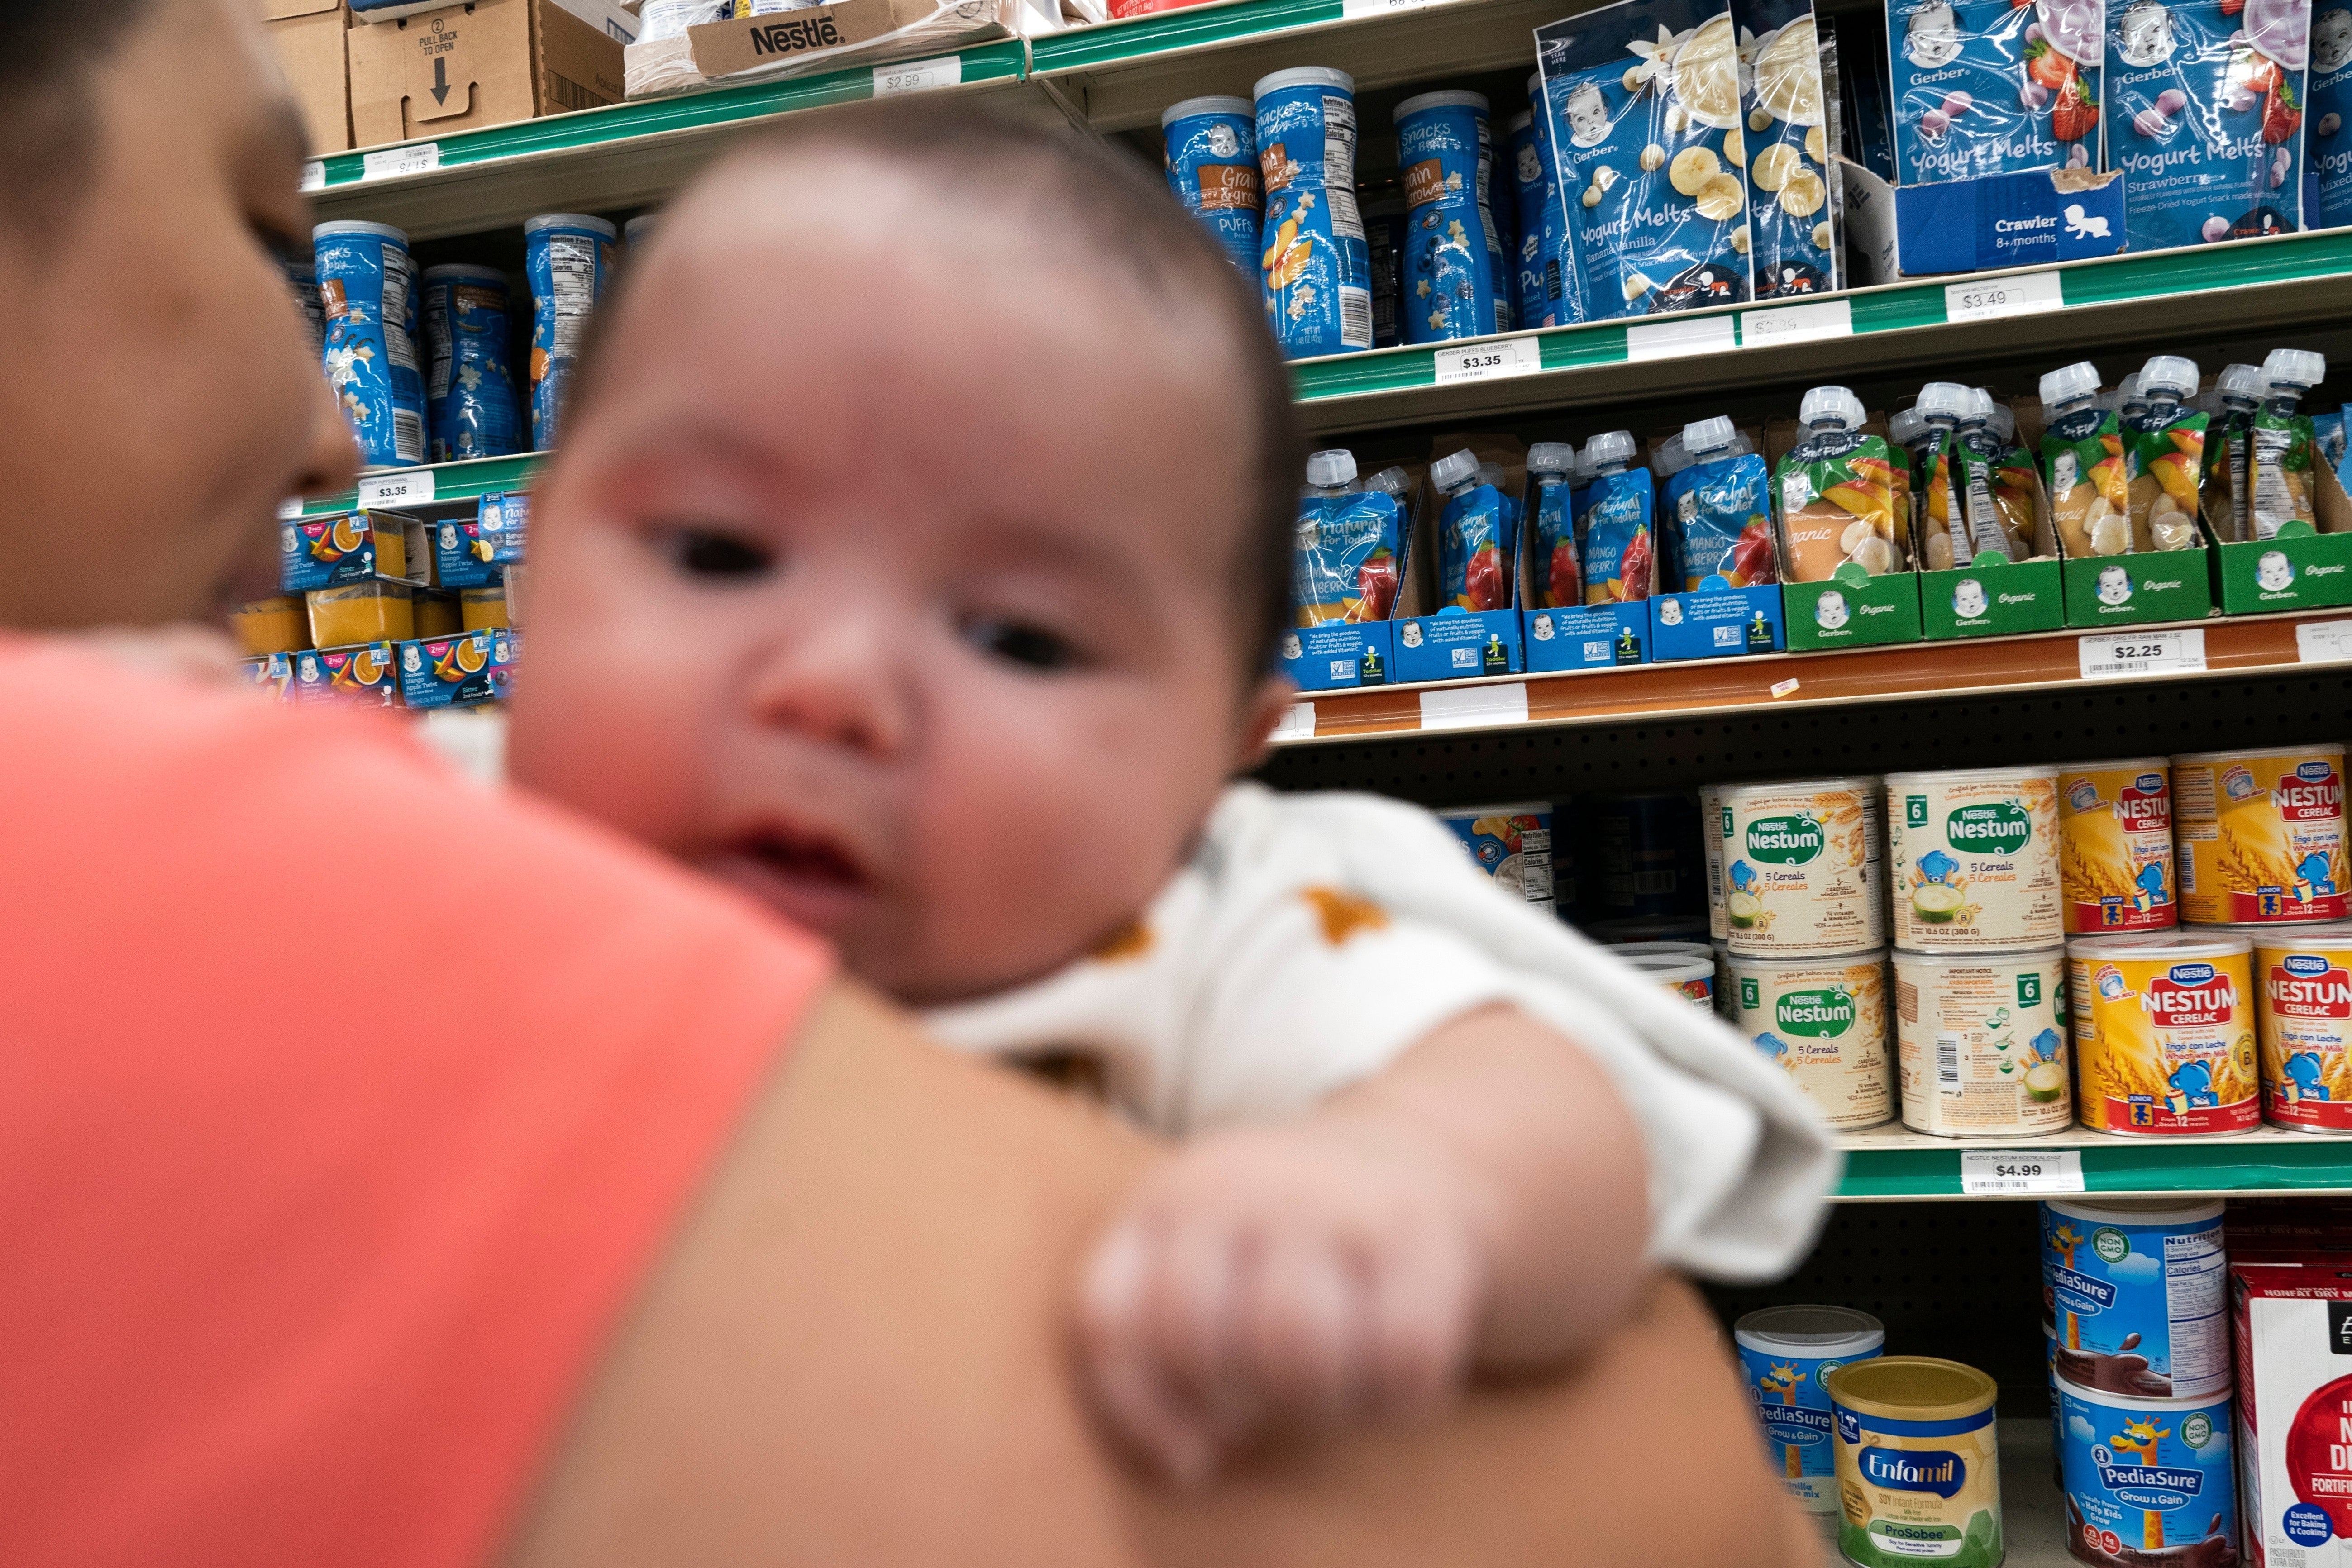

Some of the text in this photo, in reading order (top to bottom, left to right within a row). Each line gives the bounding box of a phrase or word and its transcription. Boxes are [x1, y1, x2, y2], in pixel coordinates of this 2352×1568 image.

[419, 30, 458, 47] PULL BACK
[424, 41, 454, 55] TO OPEN
[1551, 51, 1566, 60] TEAR
[1551, 56, 1566, 65] HERE
[887, 74, 919, 89] $2.99
[1910, 68, 1964, 86] Gerber
[2121, 67, 2180, 85] Gerber
[1572, 144, 1615, 165] Gerber
[1911, 135, 2054, 170] Yogurt Melts
[2121, 137, 2266, 176] Yogurt Melts
[2181, 198, 2206, 207] Yogurt
[2208, 194, 2230, 203] Snack
[1218, 218, 1253, 232] PUFFS
[1581, 203, 1691, 247] Yogurt Melts
[1995, 216, 2058, 233] Crawler
[2012, 233, 2057, 246] months
[1586, 245, 1616, 265] Banana
[1615, 236, 1656, 253] Vanilla
[1963, 292, 2006, 308] $3.49
[1437, 348, 1460, 357] GERBER
[1480, 343, 1512, 352] BLUEBERRY
[1463, 355, 1501, 369] $3.35
[379, 486, 407, 497] $3.35
[1322, 535, 1341, 547] for
[1689, 537, 1725, 550] MANGO
[1588, 547, 1616, 559] MANGO
[2305, 563, 2346, 577] Organic
[2143, 579, 2182, 592] Organic
[1998, 592, 2036, 605] Organic
[2259, 592, 2294, 601] Gerber
[1859, 604, 1895, 615] Organic
[2098, 605, 2132, 614] Gerber
[1955, 619, 1987, 627] Gerber
[1818, 629, 1849, 638] Gerber
[2115, 645, 2162, 658] $2.25
[1911, 804, 1921, 819] 6
[2297, 807, 2333, 818] CERELAC
[1949, 820, 2026, 839] Nestum
[1748, 832, 1818, 849] Nestum
[2293, 834, 2311, 844] Trigo
[1980, 861, 2014, 871] Cereals
[1773, 872, 1805, 881] Cereals
[1977, 873, 2017, 882] Cereales
[1772, 882, 1808, 891] Cereales
[2302, 903, 2314, 914] 12
[1746, 987, 1753, 1001] 6
[2024, 982, 2035, 998] 6
[2140, 987, 2238, 1012] NESTUM
[1779, 1005, 1850, 1023] Nestum
[2284, 1003, 2330, 1016] CERELAC
[2170, 1012, 2217, 1024] CERELAC
[2281, 1031, 2298, 1040] Trigo
[2316, 1034, 2342, 1043] Leche
[1807, 1044, 1839, 1054] Cereals
[2325, 1044, 2343, 1053] Milk
[1805, 1056, 1841, 1064] Cereales
[2176, 1115, 2189, 1126] 12
[1996, 1164, 2042, 1177] $4.99
[2099, 1238, 2121, 1246] NON
[2101, 1245, 2122, 1253] GMO
[2166, 1264, 2201, 1275] Calories
[2075, 1298, 2095, 1312] Gain
[1768, 1427, 1818, 1441] Grow Gain
[2188, 1423, 2206, 1432] NON
[2189, 1430, 2207, 1439] GMO
[1868, 1454, 1954, 1483] Enfamil
[2105, 1468, 2196, 1488] PediaSure
[1879, 1493, 1942, 1509] SOY Infant Formula
[2120, 1490, 2150, 1503] Grow
[2158, 1495, 2183, 1504] Gain
[2085, 1501, 2122, 1519] Help Kids
[2290, 1511, 2324, 1520] Excellent
[2090, 1512, 2110, 1525] Grow
[2289, 1518, 2327, 1530] for Baking
[1885, 1525, 1943, 1539] ProSobee
[2296, 1527, 2327, 1538] Cooking
